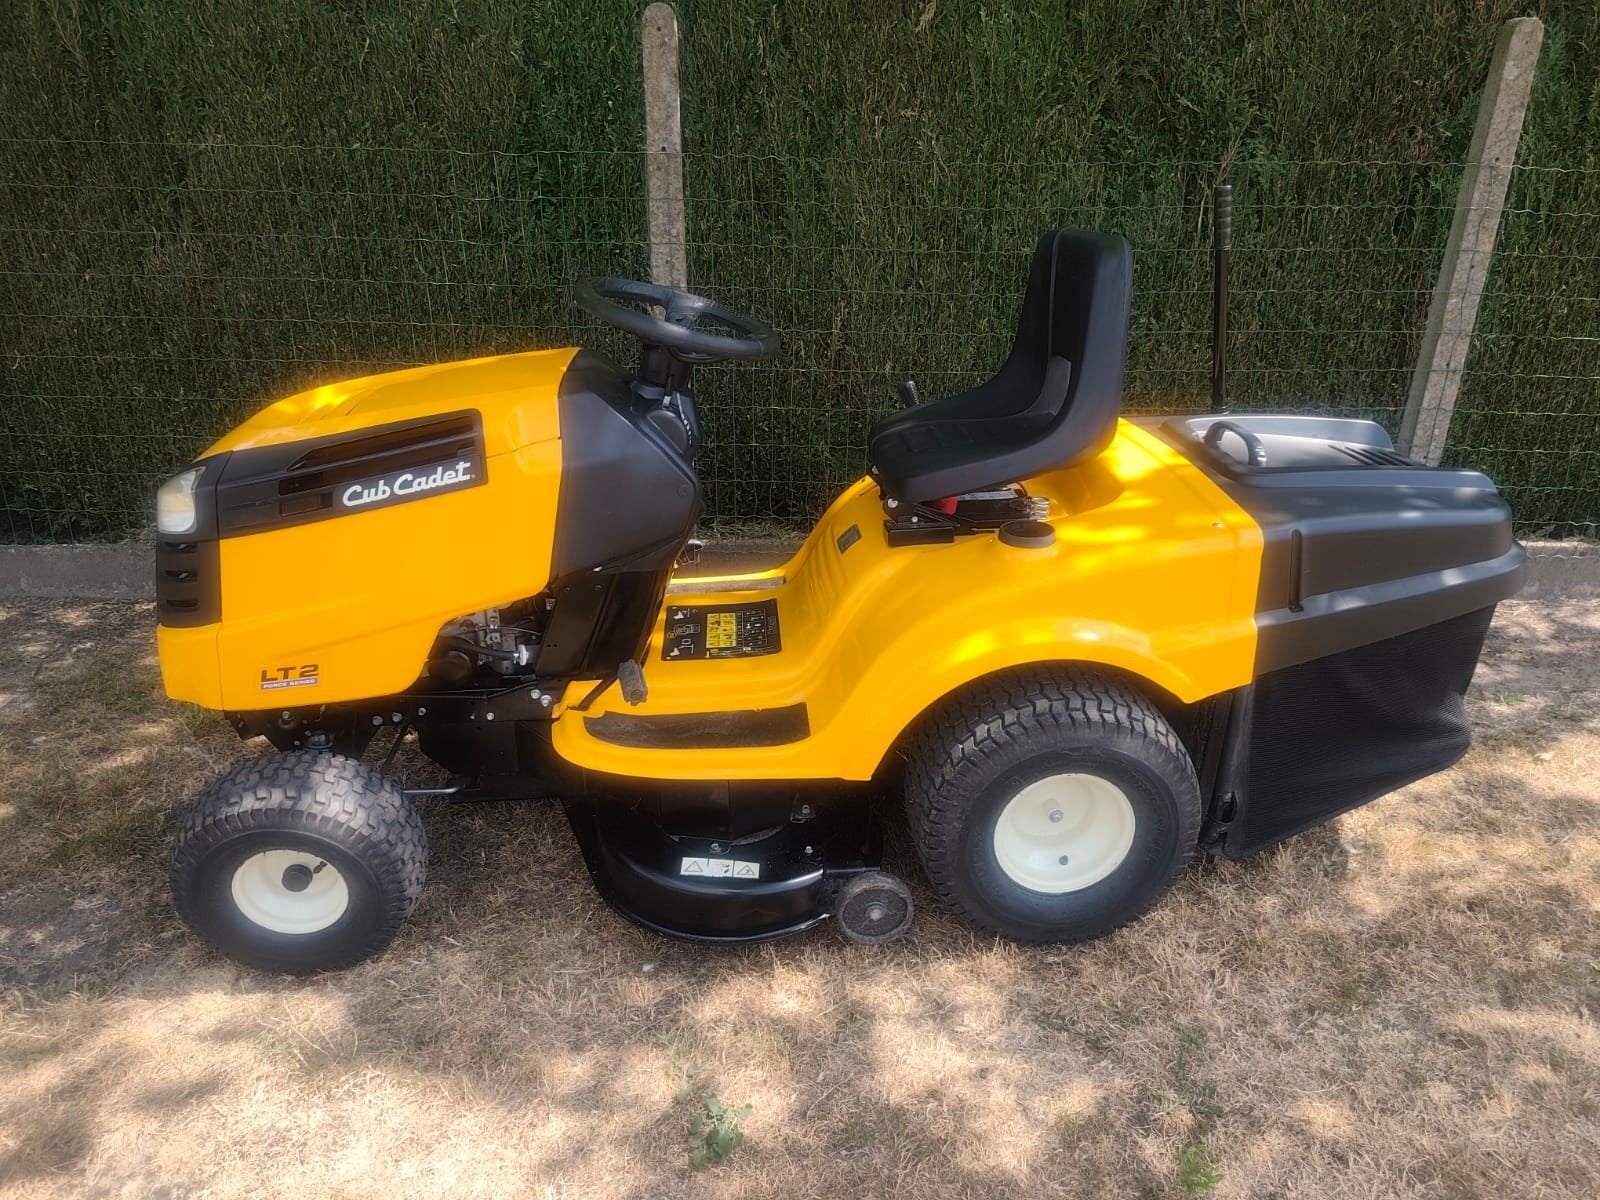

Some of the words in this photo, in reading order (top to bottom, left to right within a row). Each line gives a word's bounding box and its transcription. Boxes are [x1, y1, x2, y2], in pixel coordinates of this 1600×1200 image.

[342, 479, 391, 507] Cub
[393, 461, 471, 495] Cadet
[261, 664, 319, 682] LT2
